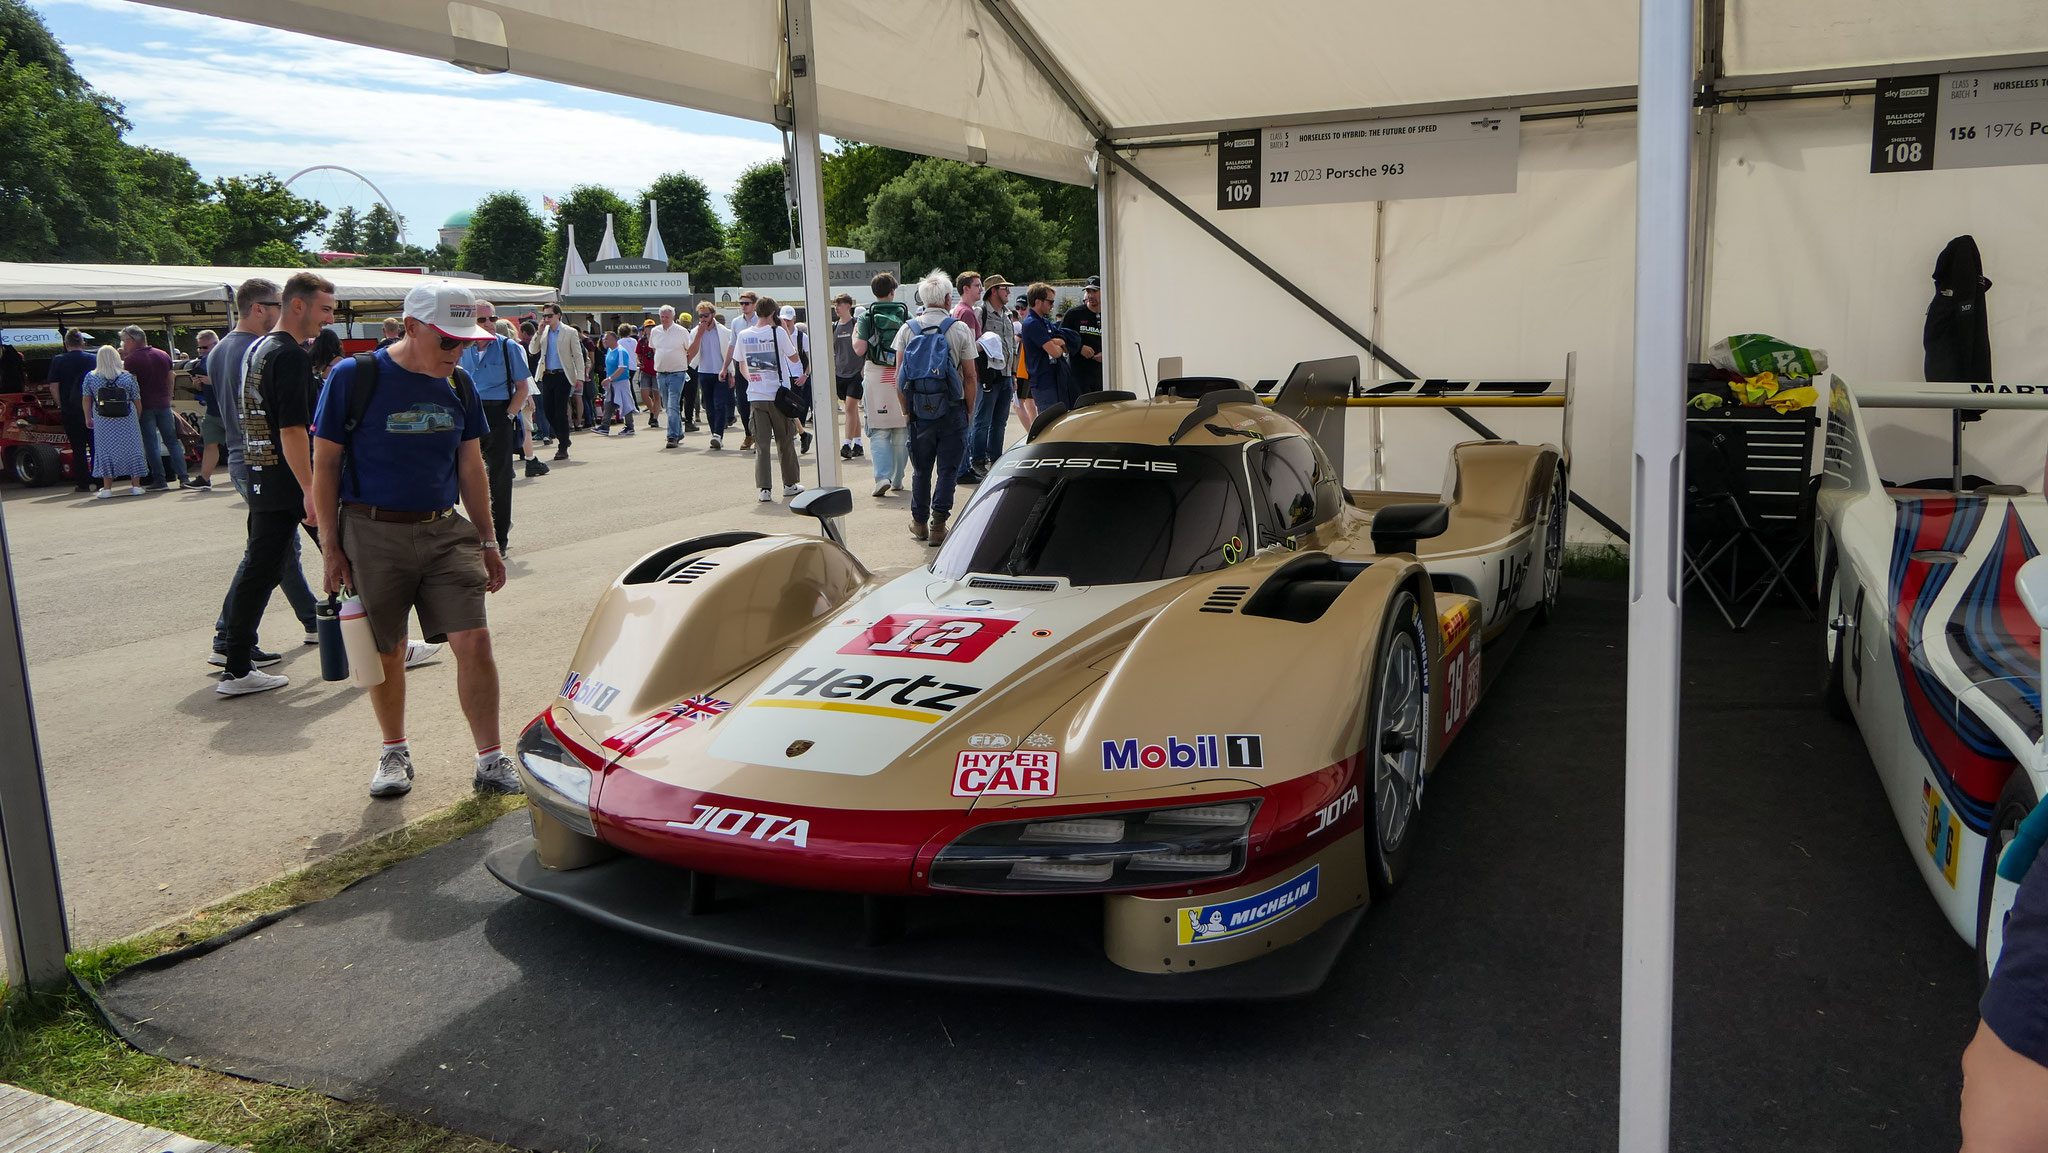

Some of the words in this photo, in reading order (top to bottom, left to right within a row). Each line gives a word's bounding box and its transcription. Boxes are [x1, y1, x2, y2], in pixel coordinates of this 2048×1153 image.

[1951, 79, 1969, 88] CLASS
[1973, 78, 1979, 87] 3
[1993, 79, 2039, 90] HORSELESS
[2042, 78, 2048, 86] T
[1884, 90, 1899, 98] sky
[1901, 87, 1928, 96] sports
[1951, 90, 1970, 99] BATCH
[1973, 89, 1977, 97] 1
[1885, 112, 1925, 120] BALLROOM
[1887, 118, 1923, 126] PADDOCK
[1299, 132, 1331, 142] HORSELESS
[1333, 131, 1341, 139] TO
[1342, 130, 1367, 139] HYBRID:
[1369, 128, 1381, 137] THE
[1382, 126, 1406, 136] FUTURE
[1408, 126, 1416, 134] OF
[1418, 124, 1437, 133] SPEED
[1950, 126, 1976, 140] 156
[1984, 123, 2024, 138] 1976
[1285, 140, 1289, 148] 2
[1885, 142, 1922, 164] 108
[1270, 171, 1289, 183] 227
[1294, 168, 1322, 182] 2023
[1326, 165, 1377, 180] Porsche
[1381, 163, 1405, 176] 963
[1225, 184, 1253, 202] 109
[828, 250, 850, 259] RIES
[575, 280, 621, 288] GOODWOOD
[622, 280, 658, 288] ORGANIC
[660, 279, 682, 287] FOOD
[13, 333, 50, 343] cream
[1000, 458, 1178, 473] PORSCHE
[867, 618, 985, 656] 12
[1416, 618, 1429, 687] MICHELIN
[559, 671, 604, 706] Mobil
[764, 667, 983, 712] Hertz
[1445, 650, 1465, 734] 38
[970, 735, 1007, 746] FIA
[962, 753, 1049, 768] HYPER
[1101, 734, 1220, 771] Mobil
[959, 766, 1050, 792] CAR
[1306, 784, 1359, 838] JOTA
[666, 803, 810, 848] JOTA
[1229, 880, 1311, 927] MICHELIN
